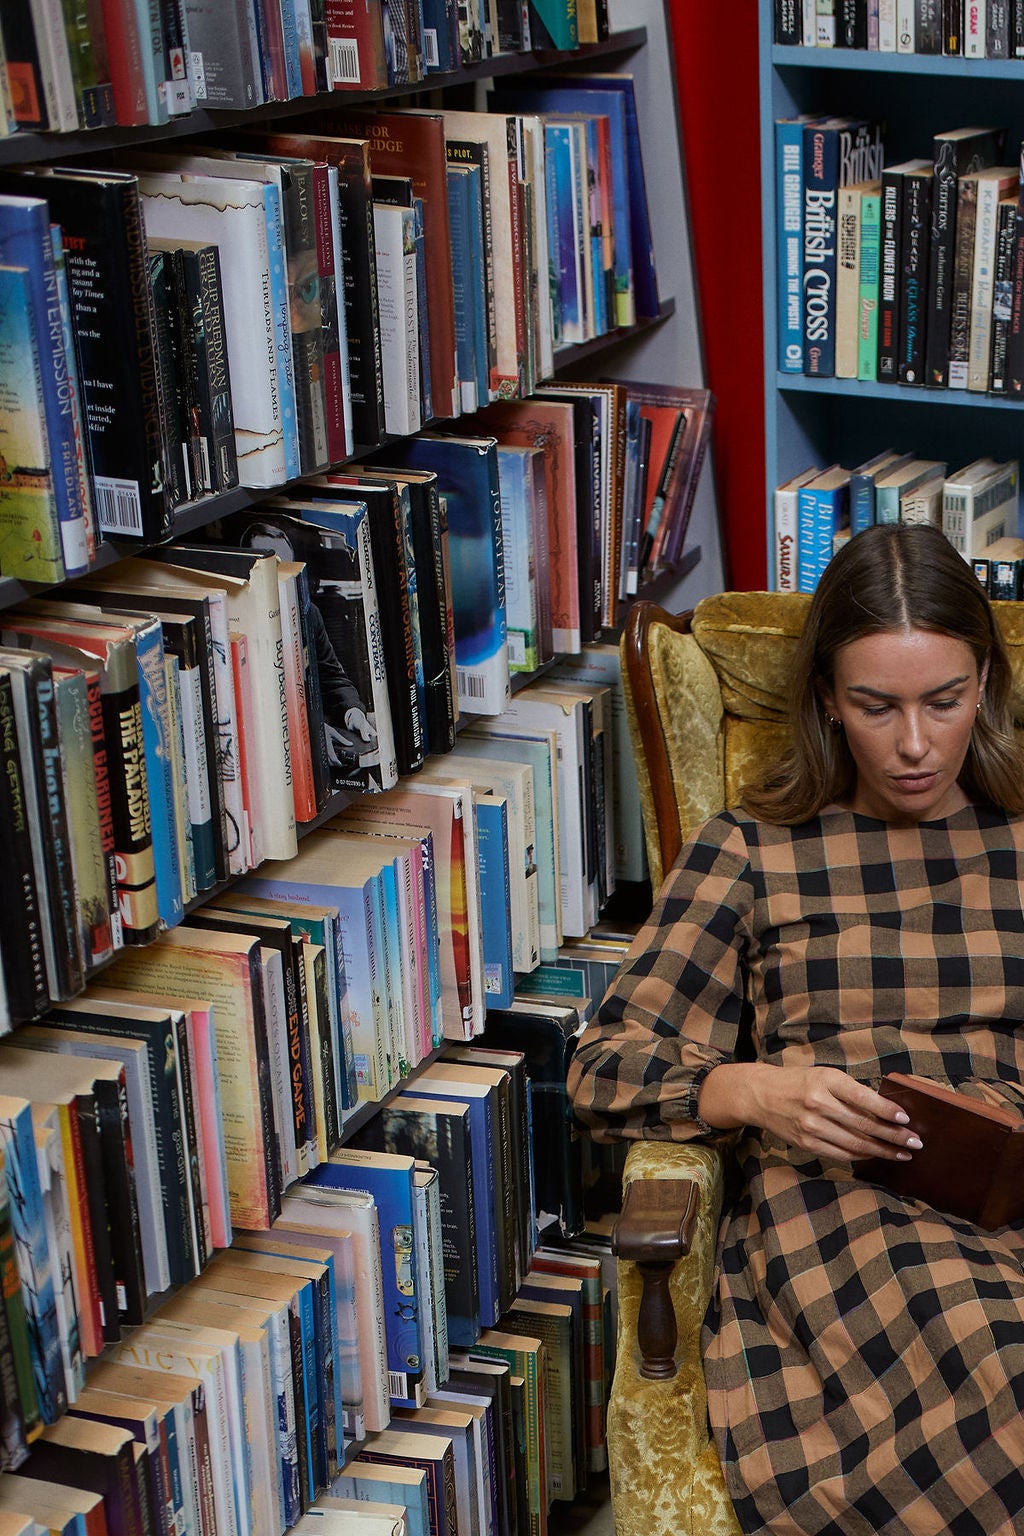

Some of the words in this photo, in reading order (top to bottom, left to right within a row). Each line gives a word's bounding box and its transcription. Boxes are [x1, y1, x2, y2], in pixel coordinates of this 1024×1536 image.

[453, 148, 472, 159] PLOT.
[483, 150, 491, 198] ANDREW
[783, 144, 801, 171] BILL
[812, 133, 825, 179] Granger
[293, 171, 311, 246] JEALOUSY
[321, 179, 330, 236] IMPOSSIBLE
[510, 163, 520, 263] SWEETSMOKE
[784, 174, 801, 231] GRANGER
[884, 186, 897, 221] KILLERS
[937, 175, 955, 230] SEDITION
[804, 188, 835, 263] British
[861, 224, 877, 243] BILL
[1017, 237, 1024, 250] THE
[41, 235, 53, 261] THE
[122, 191, 156, 331] INADMISSIBLE
[787, 237, 799, 276] BURNING
[883, 240, 895, 273] FLOWER
[936, 245, 946, 285] Katharine
[997, 256, 1006, 279] Here
[1016, 251, 1024, 278] CLOTHES
[206, 252, 220, 302] PHILIP
[405, 259, 413, 286] SUE
[787, 278, 799, 292] THE
[883, 275, 895, 301] MOON
[1016, 279, 1023, 290] ON
[262, 270, 272, 336] THREADS
[406, 291, 415, 334] FROST
[787, 295, 800, 330] APOSTLE
[906, 286, 917, 322] GLASS
[936, 286, 945, 310] Grant
[1014, 291, 1022, 310] THEIR
[42, 271, 72, 416] INTERMISSION
[1013, 312, 1021, 334] BACKS
[210, 306, 226, 387] FRIEDMAN
[266, 338, 275, 364] AND
[372, 327, 380, 369] NEVER
[135, 340, 161, 442] EVIDENCE
[269, 368, 280, 421] FLAMES
[375, 370, 383, 404] FEAR
[95, 405, 116, 414] inside
[592, 416, 600, 447] ALL
[490, 489, 505, 609] JONATHAN
[203, 615, 212, 651] ALEX
[368, 614, 382, 683] CONTRACT
[400, 593, 416, 680] MORNING
[273, 639, 286, 672] Buy
[206, 655, 218, 724] GARLAND
[277, 671, 288, 710] Back
[296, 683, 305, 699] for
[409, 683, 417, 709] PAUL
[444, 667, 454, 720] Garrison
[36, 678, 55, 745] Don
[87, 687, 106, 744] SCOT
[118, 704, 136, 743] THE
[196, 703, 204, 736] Sand
[281, 712, 290, 739] the
[411, 713, 421, 748] GARRISON
[199, 739, 208, 772] Fish
[282, 739, 292, 786] Dawn
[92, 751, 114, 853] GARDNER
[122, 744, 145, 843] PALADIN
[22, 874, 35, 912] KATY
[28, 922, 45, 991] GARDNER
[298, 954, 306, 997] HOLD
[269, 983, 279, 1038] SCOTS
[285, 967, 294, 1016] GIBBONS
[301, 1002, 309, 1024] ON
[288, 1013, 300, 1060] END
[273, 1042, 284, 1095] QUAIR
[170, 1088, 180, 1120] anne
[293, 1063, 305, 1129] GAME
[262, 1104, 271, 1146] TIGER
[172, 1129, 185, 1185] giardini
[265, 1149, 276, 1204] WARRIOR
